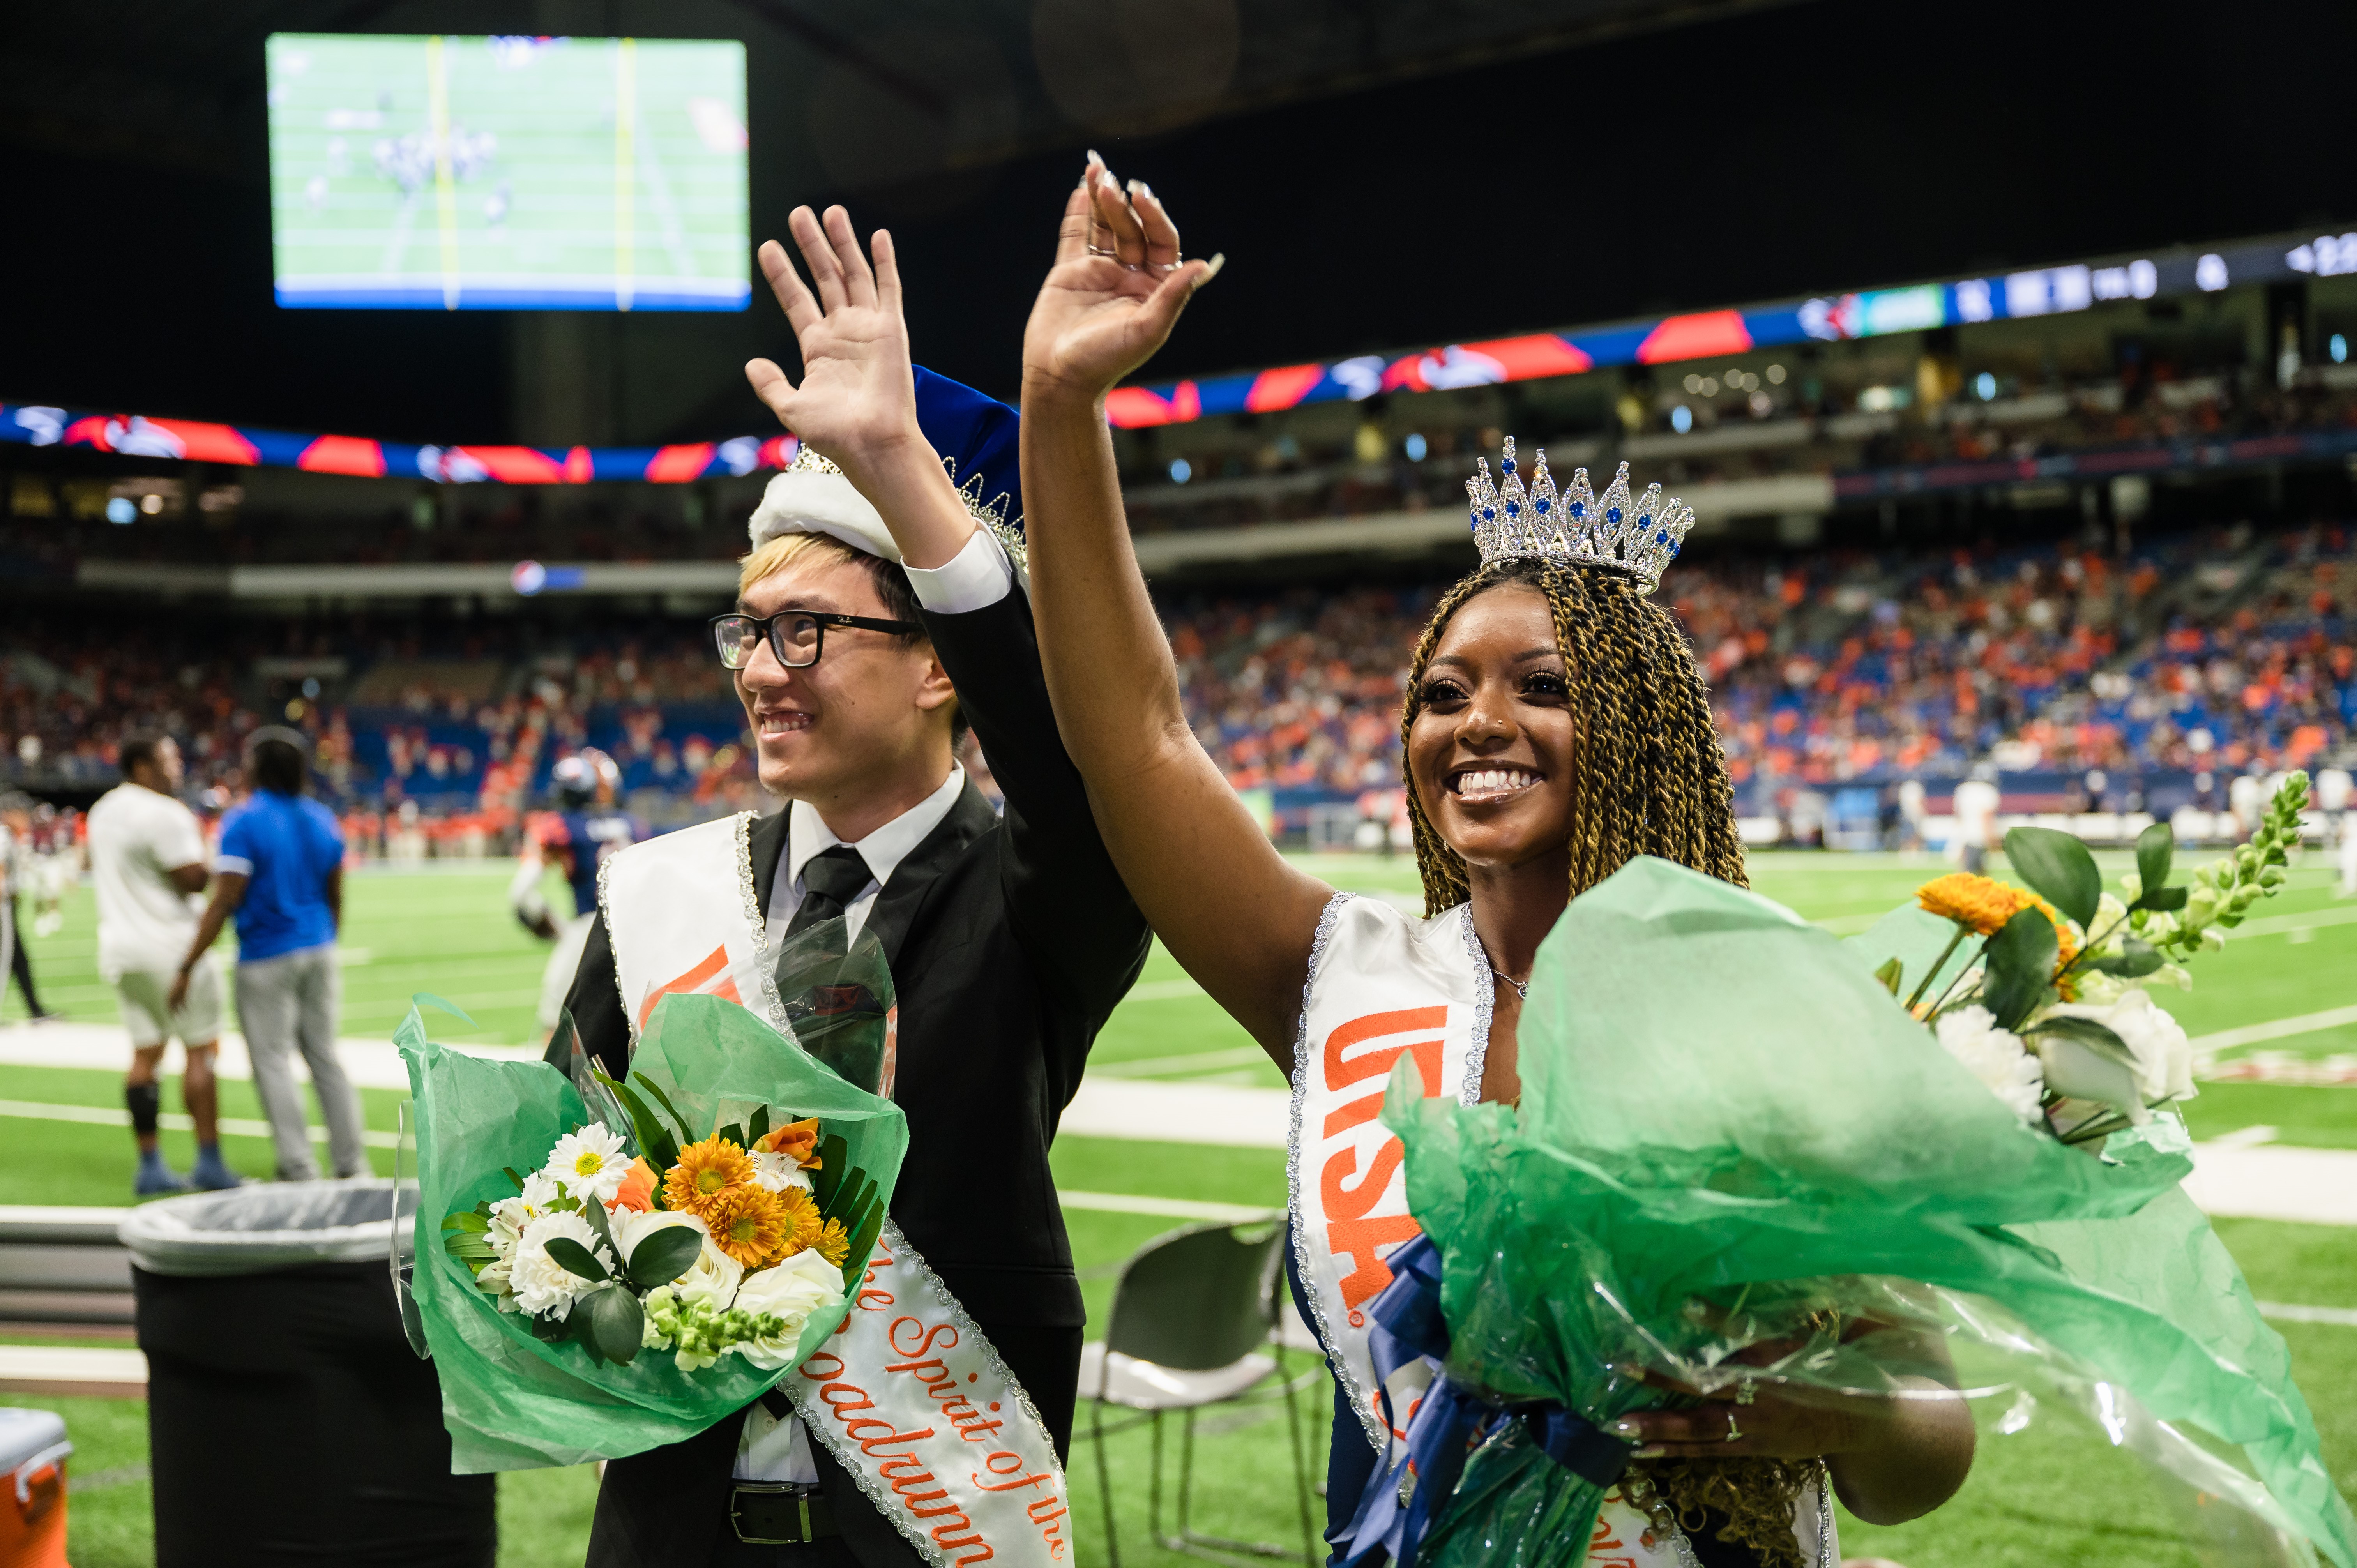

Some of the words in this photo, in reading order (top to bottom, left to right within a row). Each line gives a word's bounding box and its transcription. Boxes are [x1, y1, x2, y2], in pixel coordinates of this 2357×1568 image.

[798, 1312, 995, 1568] oadrunn
[856, 1236, 895, 1311] he
[885, 1315, 1004, 1441] Spirit
[972, 1451, 1055, 1491] of
[1028, 1495, 1067, 1563] the
